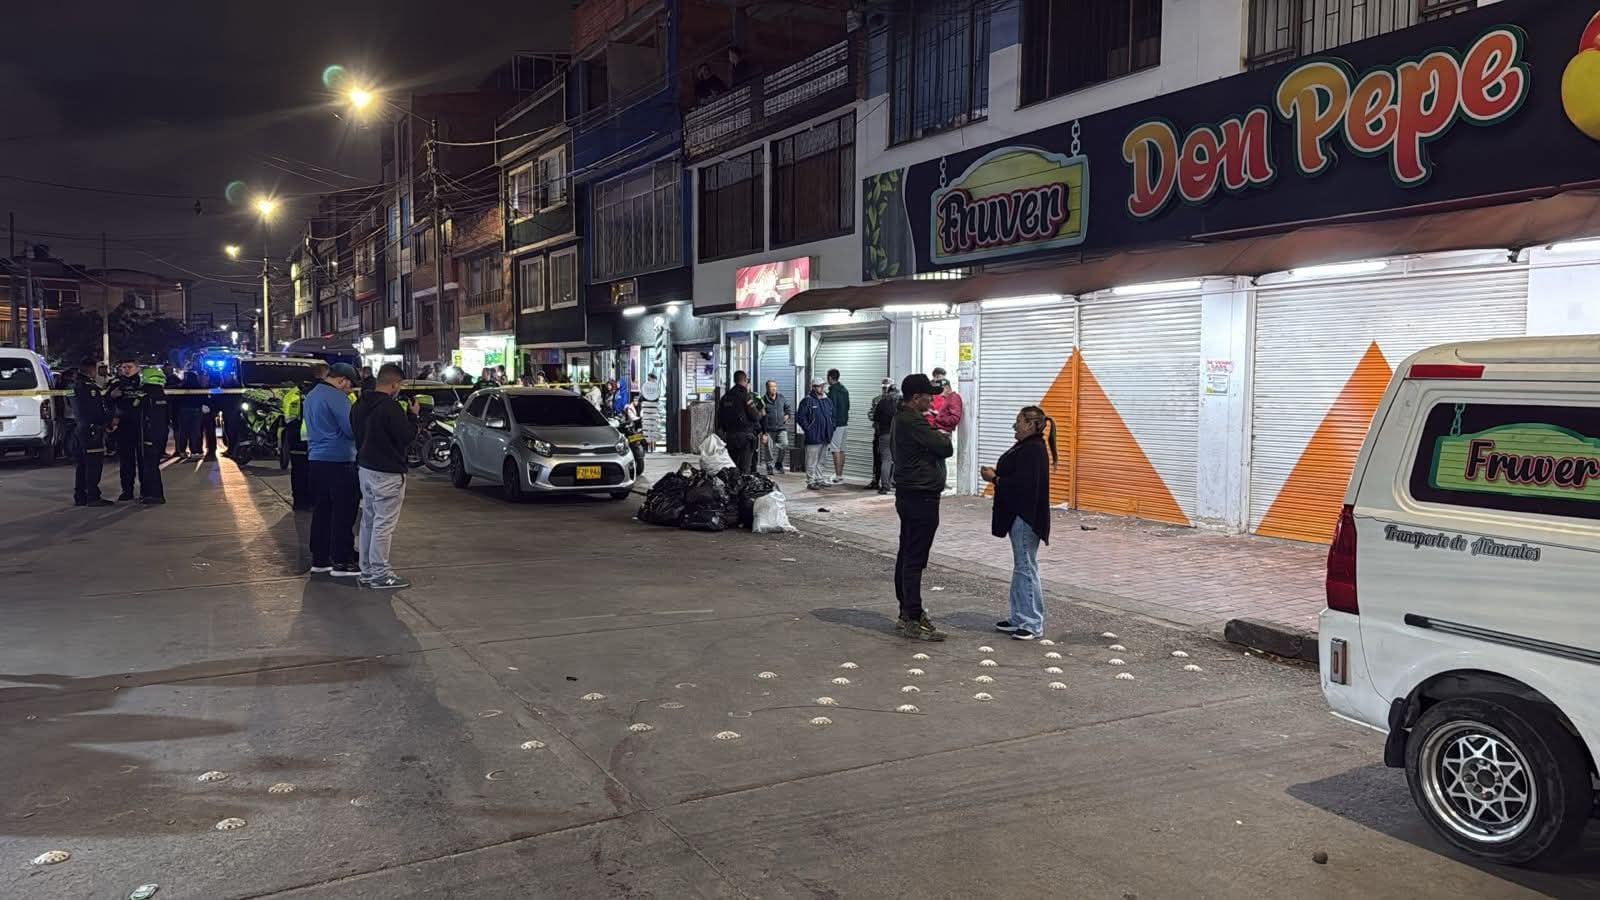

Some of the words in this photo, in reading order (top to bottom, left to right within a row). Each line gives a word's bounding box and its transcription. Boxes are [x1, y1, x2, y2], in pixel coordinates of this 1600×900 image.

[1123, 107, 1274, 218] Don
[1276, 29, 1526, 184] Pepe
[940, 184, 1069, 253] Fruver
[1466, 438, 1600, 488] Fruver
[1384, 525, 1450, 550] Transporte
[1450, 535, 1468, 552] de
[1470, 537, 1541, 562] Alimentos
